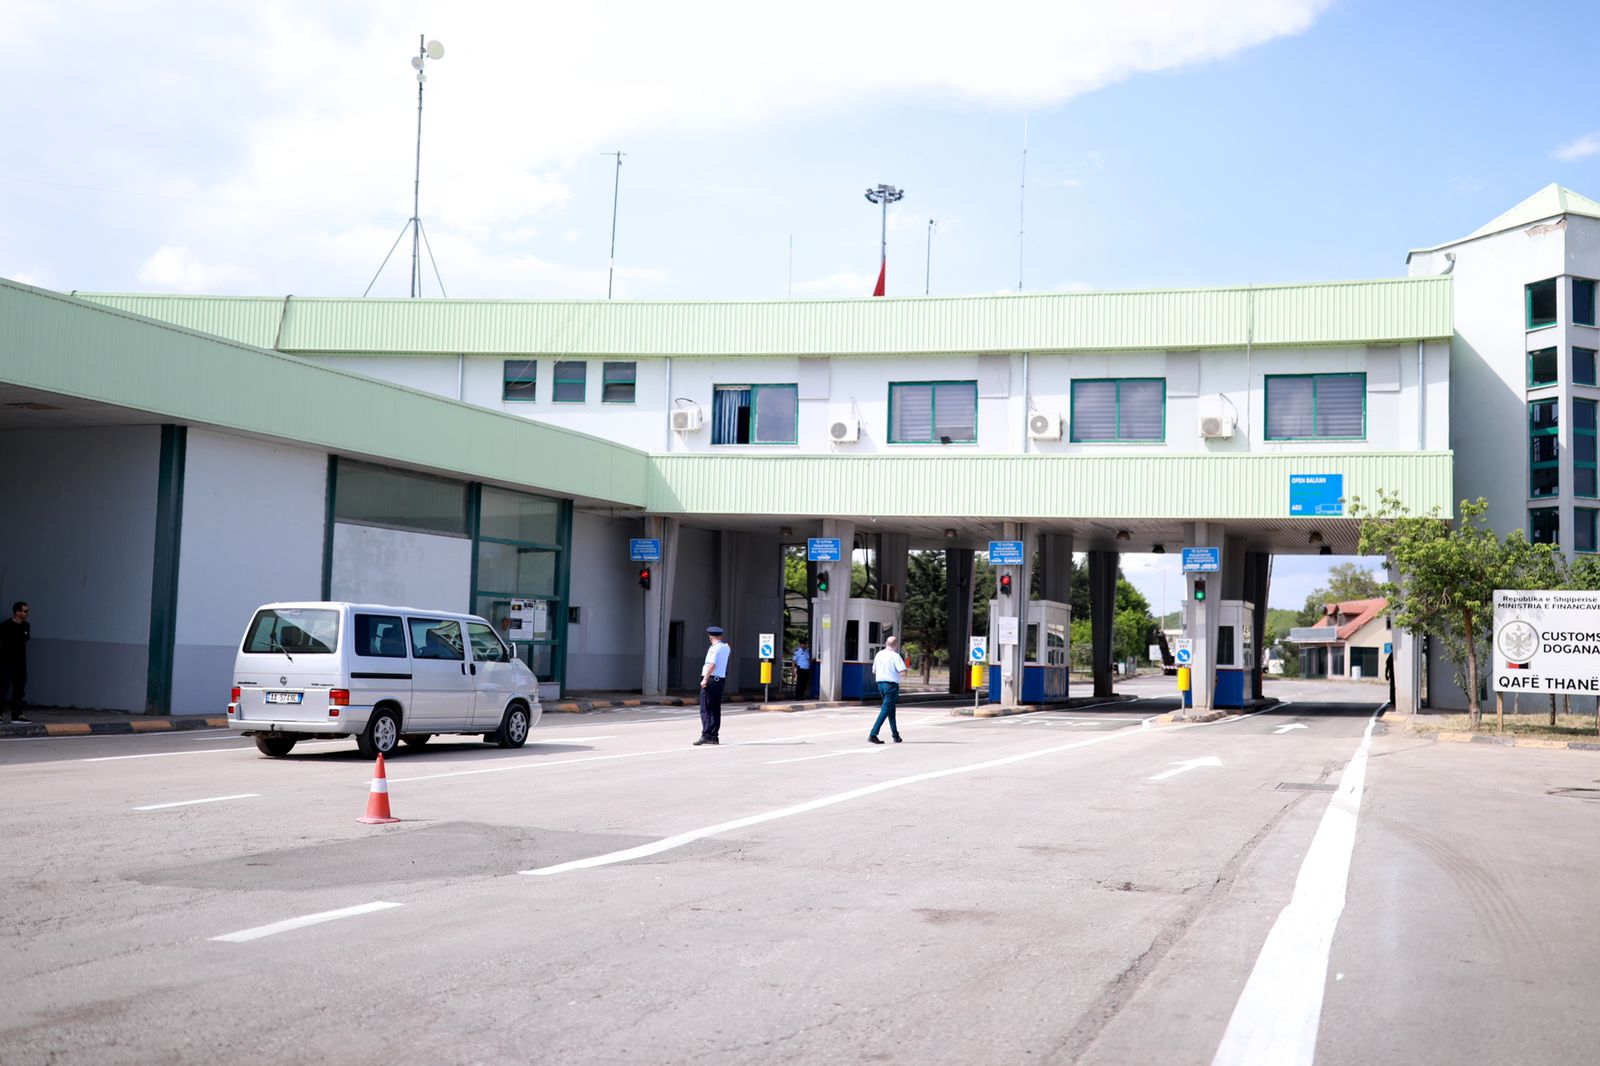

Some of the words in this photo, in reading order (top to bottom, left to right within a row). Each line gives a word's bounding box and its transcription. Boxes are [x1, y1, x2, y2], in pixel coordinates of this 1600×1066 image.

[1542, 632, 1600, 642] CUSTOMS
[1544, 644, 1600, 654] DOGANA
[1498, 674, 1540, 688] QAFË
[1544, 676, 1600, 690] THANË
